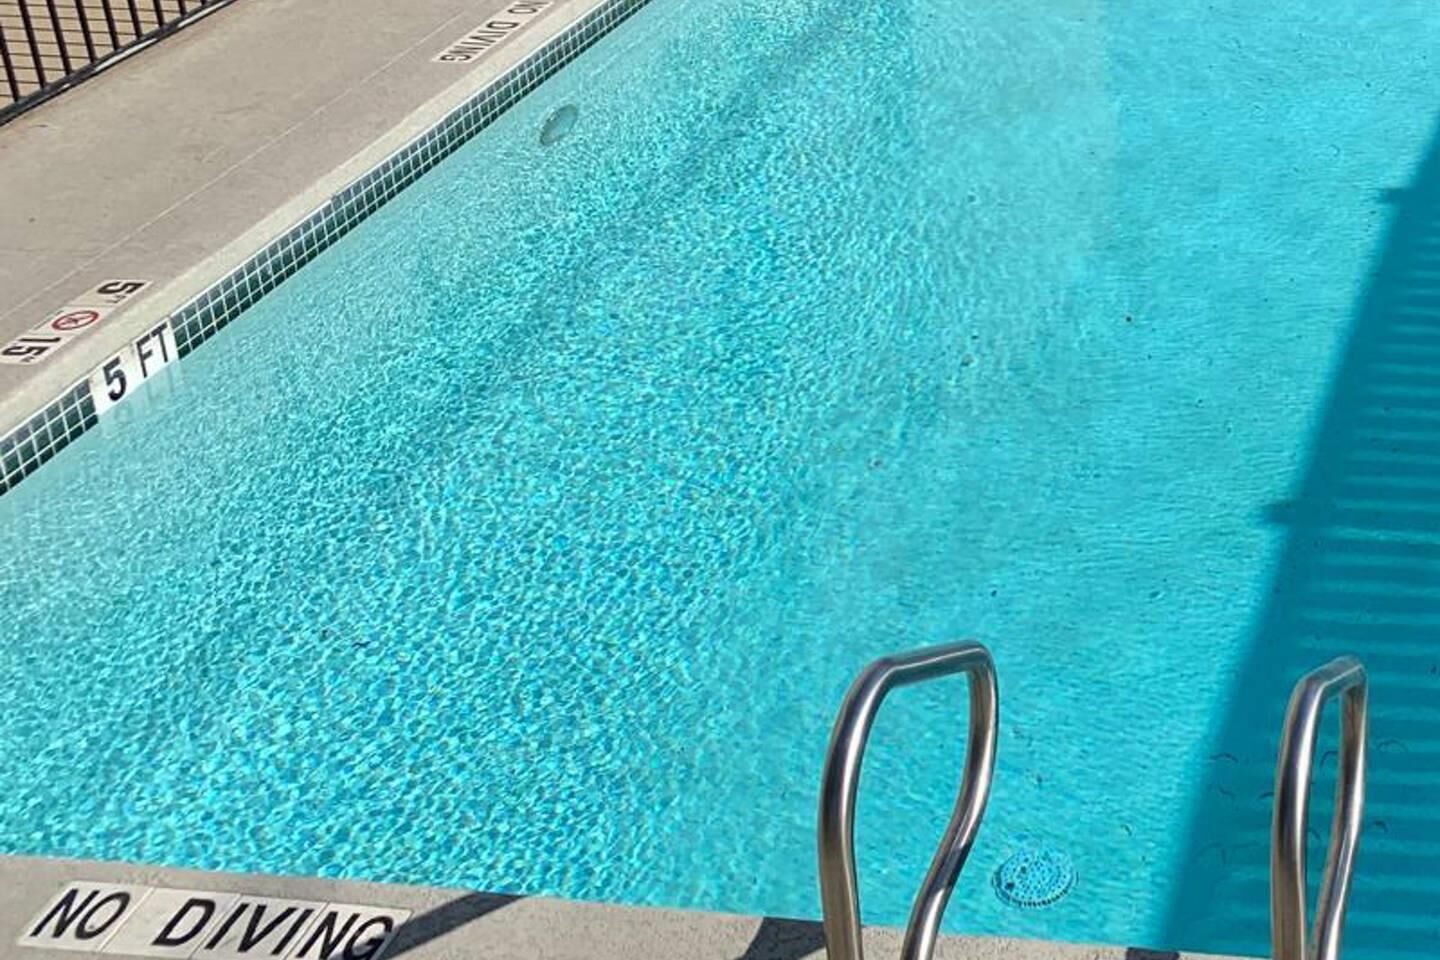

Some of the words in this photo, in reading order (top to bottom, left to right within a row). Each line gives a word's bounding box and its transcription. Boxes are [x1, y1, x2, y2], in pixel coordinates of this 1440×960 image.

[440, 21, 520, 62] DIVING
[97, 281, 145, 294] 5
[103, 356, 127, 401] 5
[136, 322, 169, 378] FT
[30, 888, 131, 940] NO
[152, 898, 394, 960] DIVING
